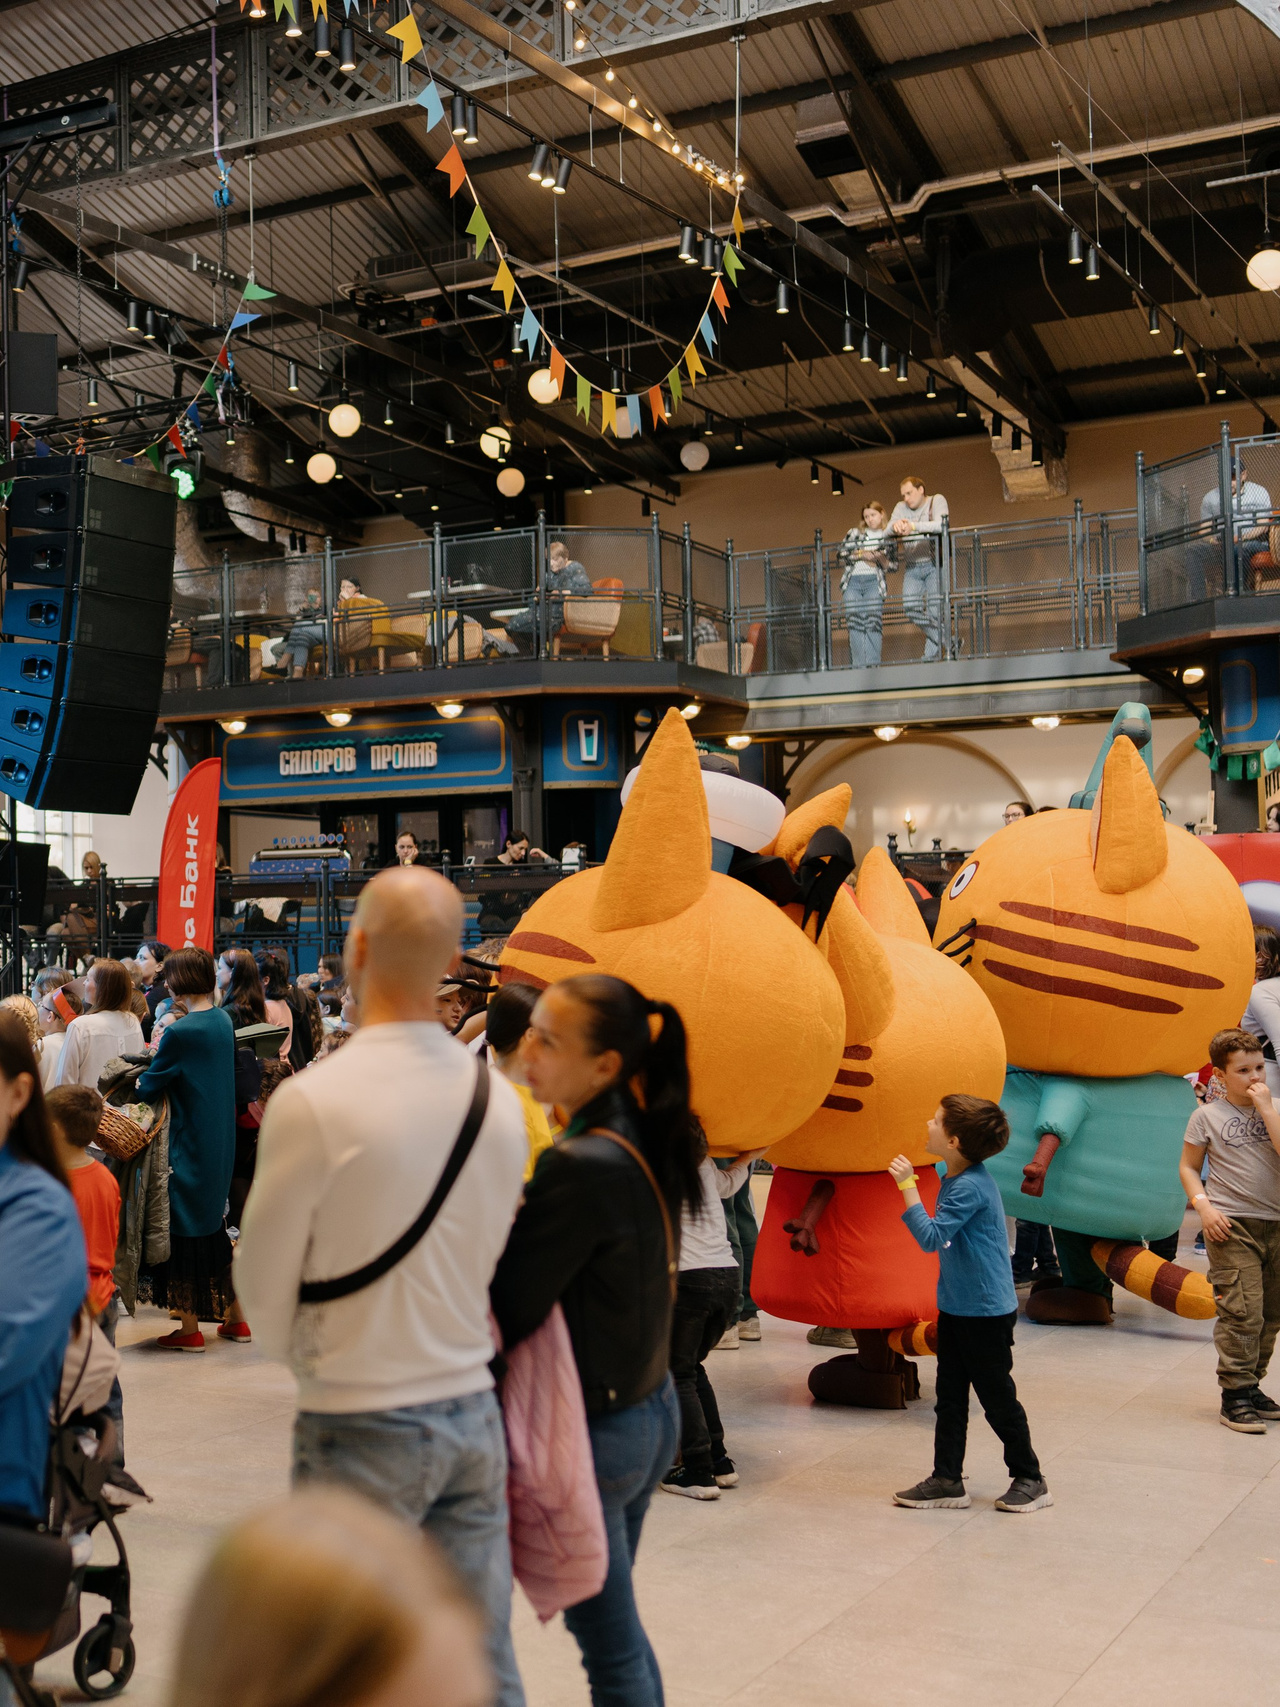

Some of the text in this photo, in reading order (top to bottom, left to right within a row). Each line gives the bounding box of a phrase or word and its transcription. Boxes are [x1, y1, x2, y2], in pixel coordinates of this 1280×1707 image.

[279, 742, 438, 776] СИДОРОВ ПРОЛИВ
[179, 813, 200, 909] Банк
